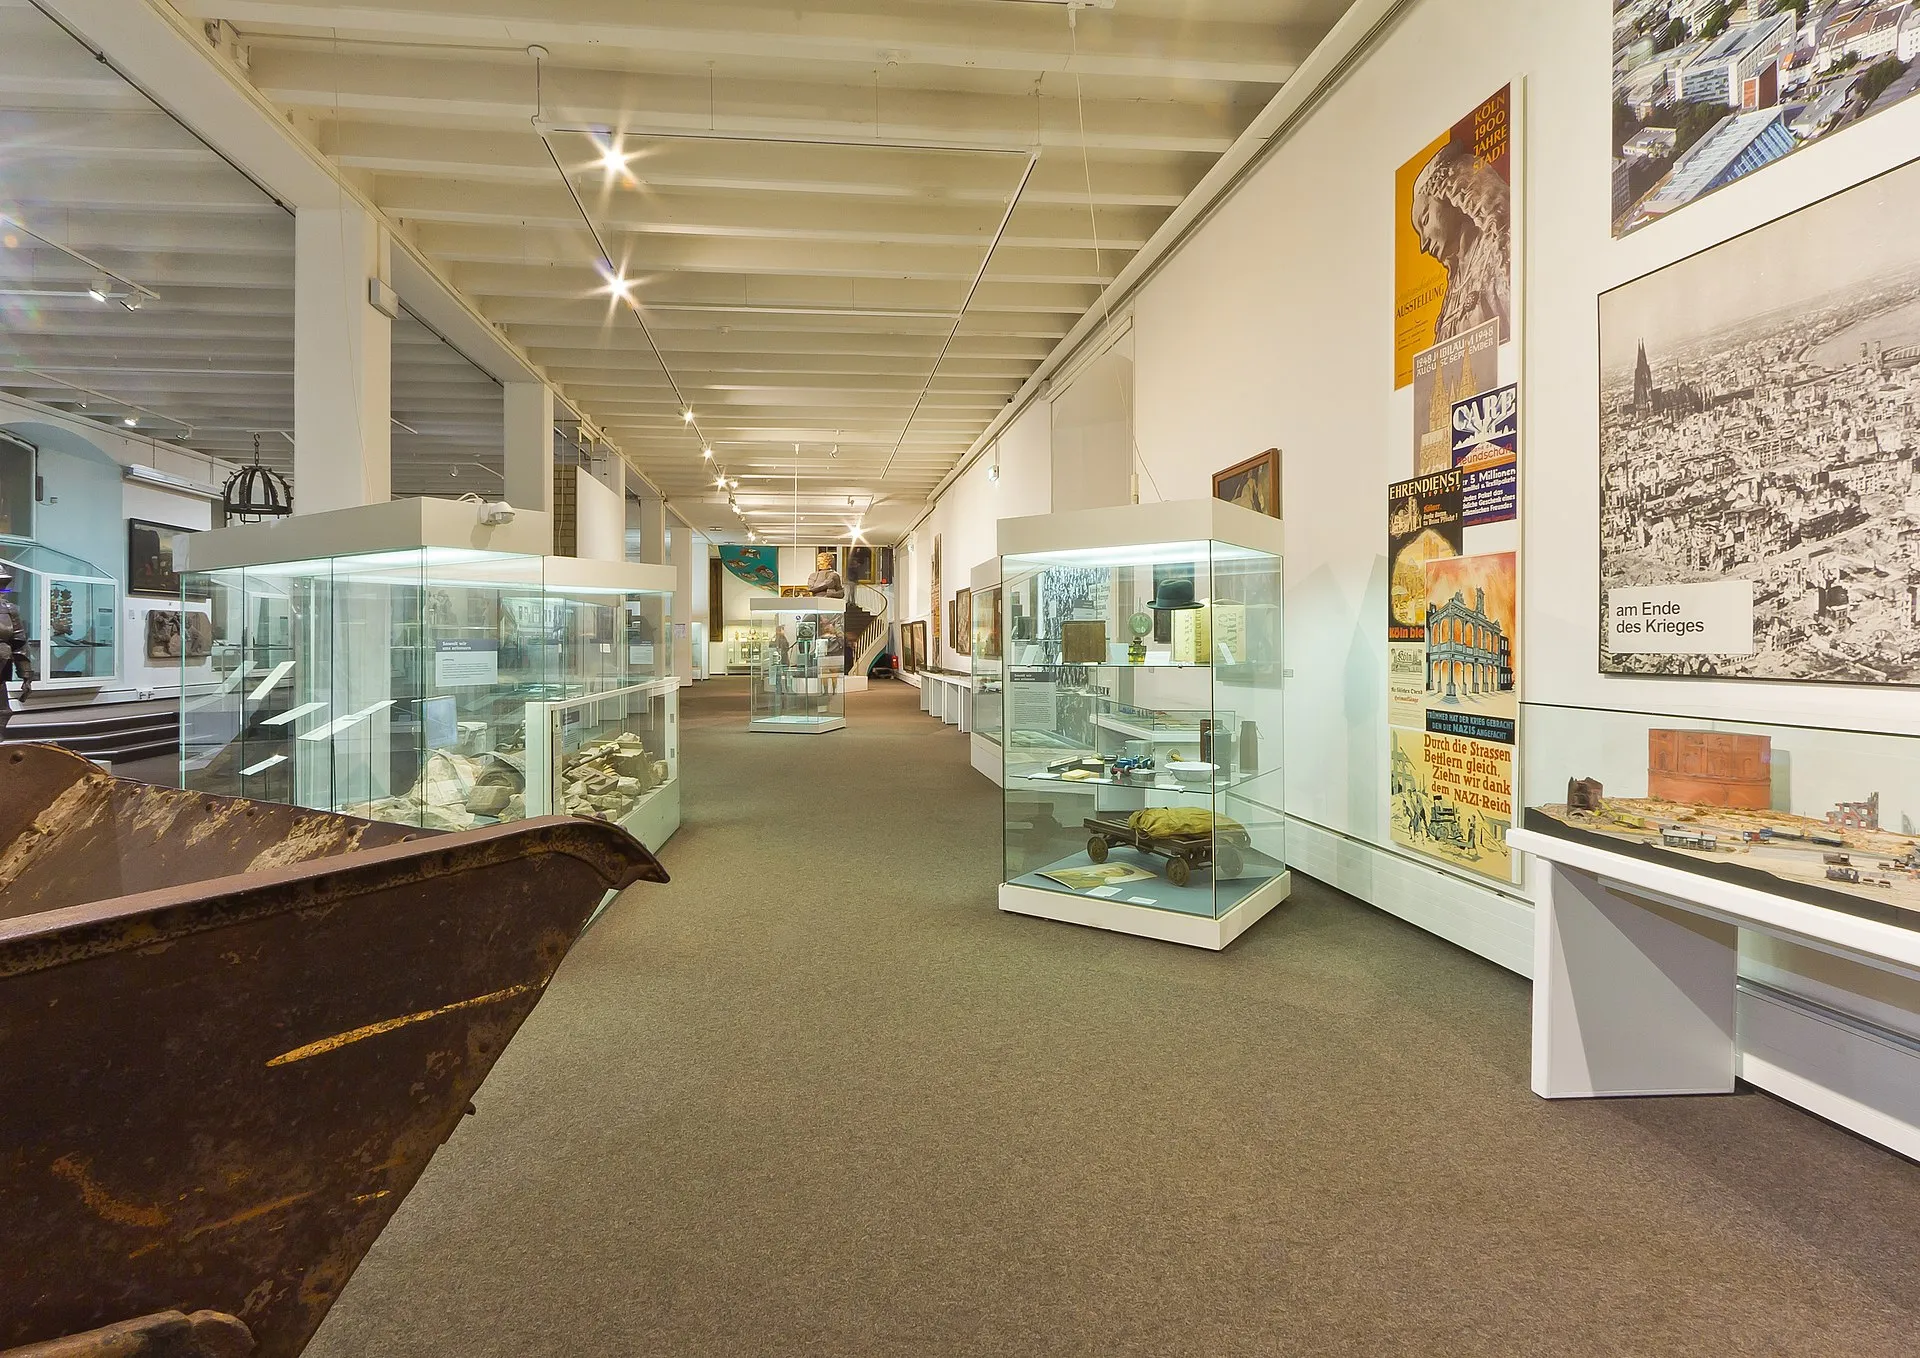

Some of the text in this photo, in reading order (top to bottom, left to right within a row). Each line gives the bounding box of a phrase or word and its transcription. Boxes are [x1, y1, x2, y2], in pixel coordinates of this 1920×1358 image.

[1475, 92, 1505, 126] KÖLN
[1475, 110, 1505, 141] 1900
[1474, 124, 1507, 158] JAHRE
[1473, 141, 1506, 175] STADT
[1396, 283, 1444, 320] AUSSTELLUNG
[1475, 326, 1494, 344] 1948
[1453, 388, 1515, 431] CARE
[1390, 470, 1461, 500] EHRENDIENST
[1470, 474, 1475, 484] 5
[1479, 469, 1516, 482] Millionen
[1616, 601, 1681, 617] am Ende
[1410, 626, 1424, 638] ble
[1616, 618, 1705, 637] des Krieges
[1443, 723, 1452, 732] DIE
[1452, 724, 1476, 735] NAZIS
[1476, 728, 1507, 740] ANGEFACHT
[1460, 715, 1470, 724] DER
[1470, 717, 1485, 726] KRIEG
[1486, 719, 1513, 730] GEBRACHT
[1424, 734, 1511, 762] Durch die Strassen
[1424, 749, 1501, 778] Bettlern gleich,
[1432, 764, 1512, 796] Ziehn wir dank
[1431, 781, 1512, 814] dem NAZI-Reich
